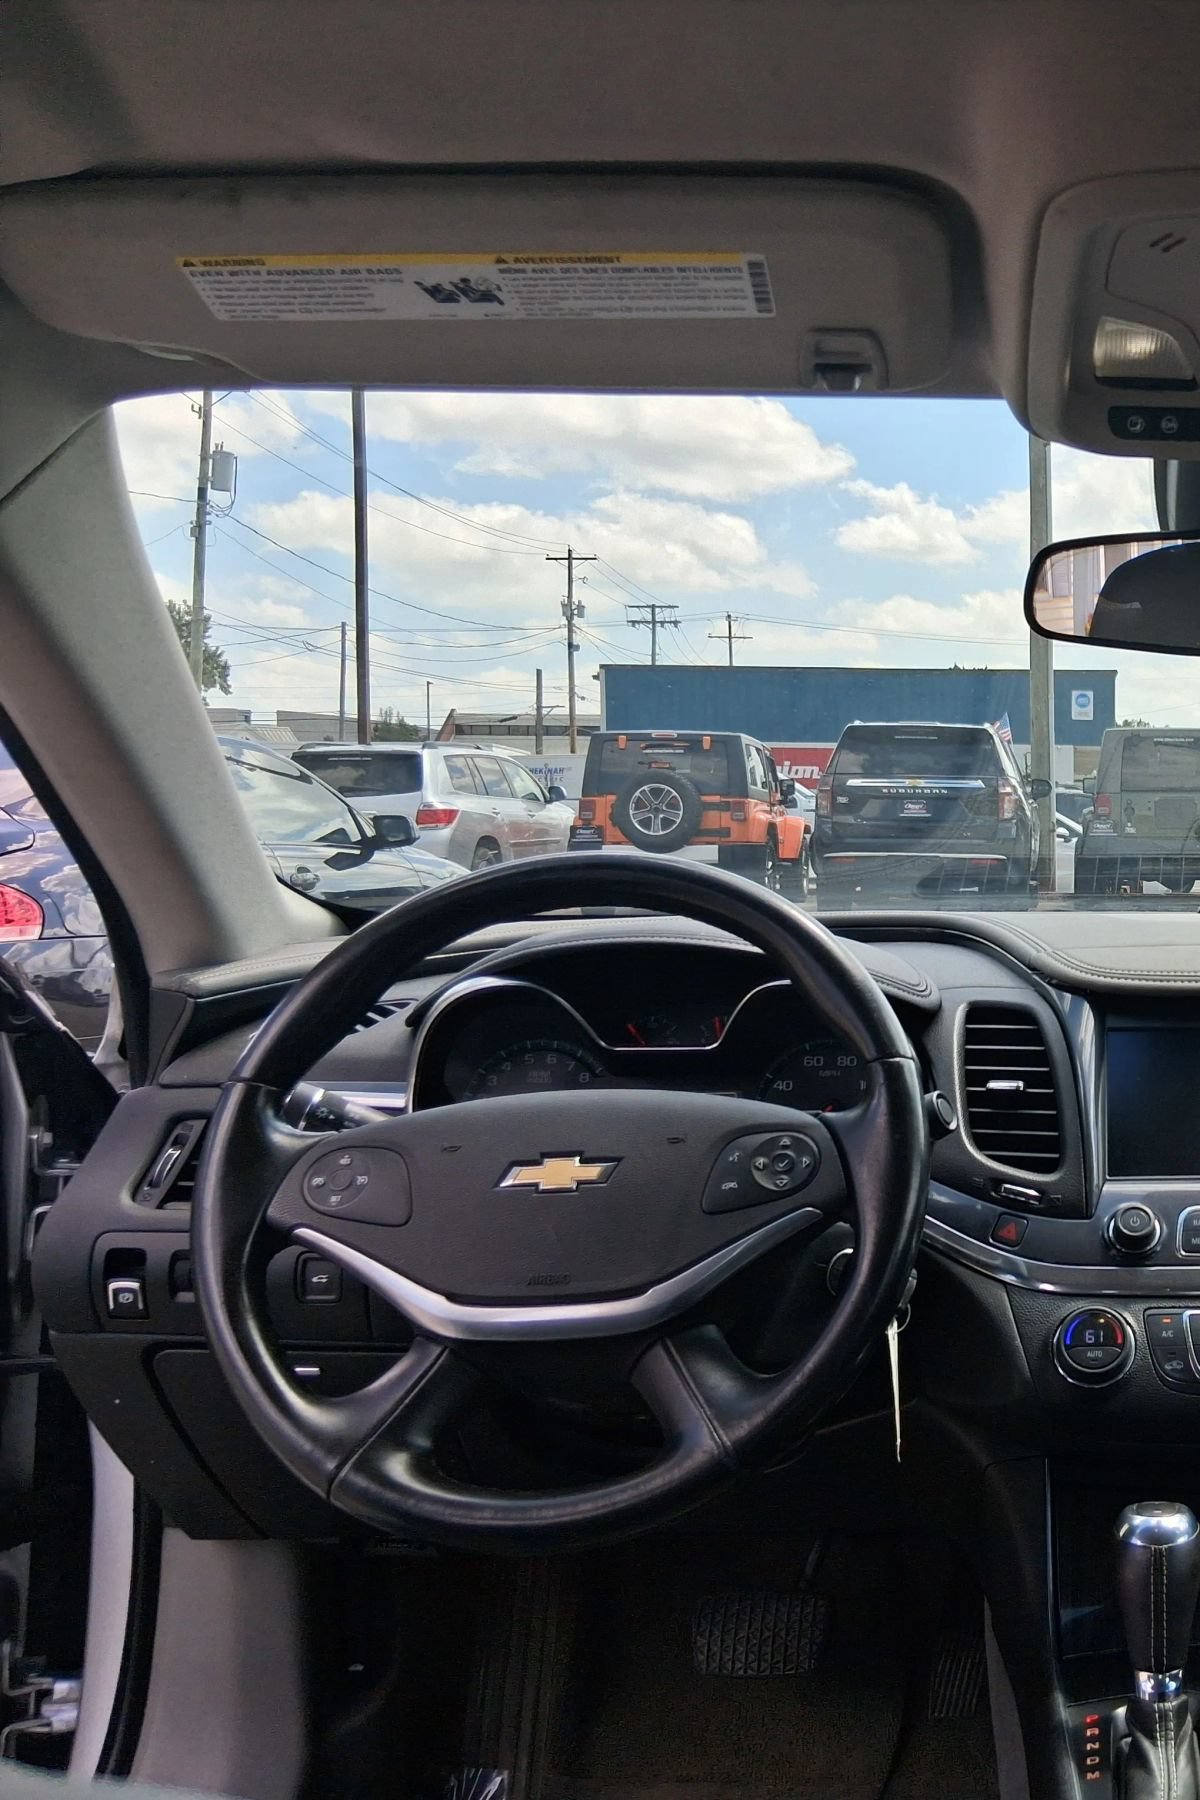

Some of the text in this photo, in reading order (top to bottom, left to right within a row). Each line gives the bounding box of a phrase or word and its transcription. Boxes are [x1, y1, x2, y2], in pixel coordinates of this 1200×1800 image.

[199, 258, 267, 267] WARNING
[513, 255, 622, 265] AVERTISSEMENT
[189, 270, 224, 278] EVEN
[266, 268, 336, 277] ADVANCED
[340, 268, 361, 276] AIR
[366, 267, 403, 275] BAGS
[524, 1054, 535, 1065] 5
[546, 1053, 557, 1065] 6
[803, 1055, 857, 1067] 60 80
[501, 1061, 512, 1071] 4
[565, 1061, 577, 1072] 7
[487, 1075, 497, 1086] 3
[578, 1072, 590, 1083] 8
[773, 1080, 793, 1091] 40
[1085, 1329, 1104, 1344] 61
[1161, 1330, 1174, 1338] A/C
[1085, 1714, 1100, 1724] P
[1086, 1741, 1100, 1751] N
[1086, 1756, 1100, 1765] D
[1086, 1771, 1100, 1781] M
